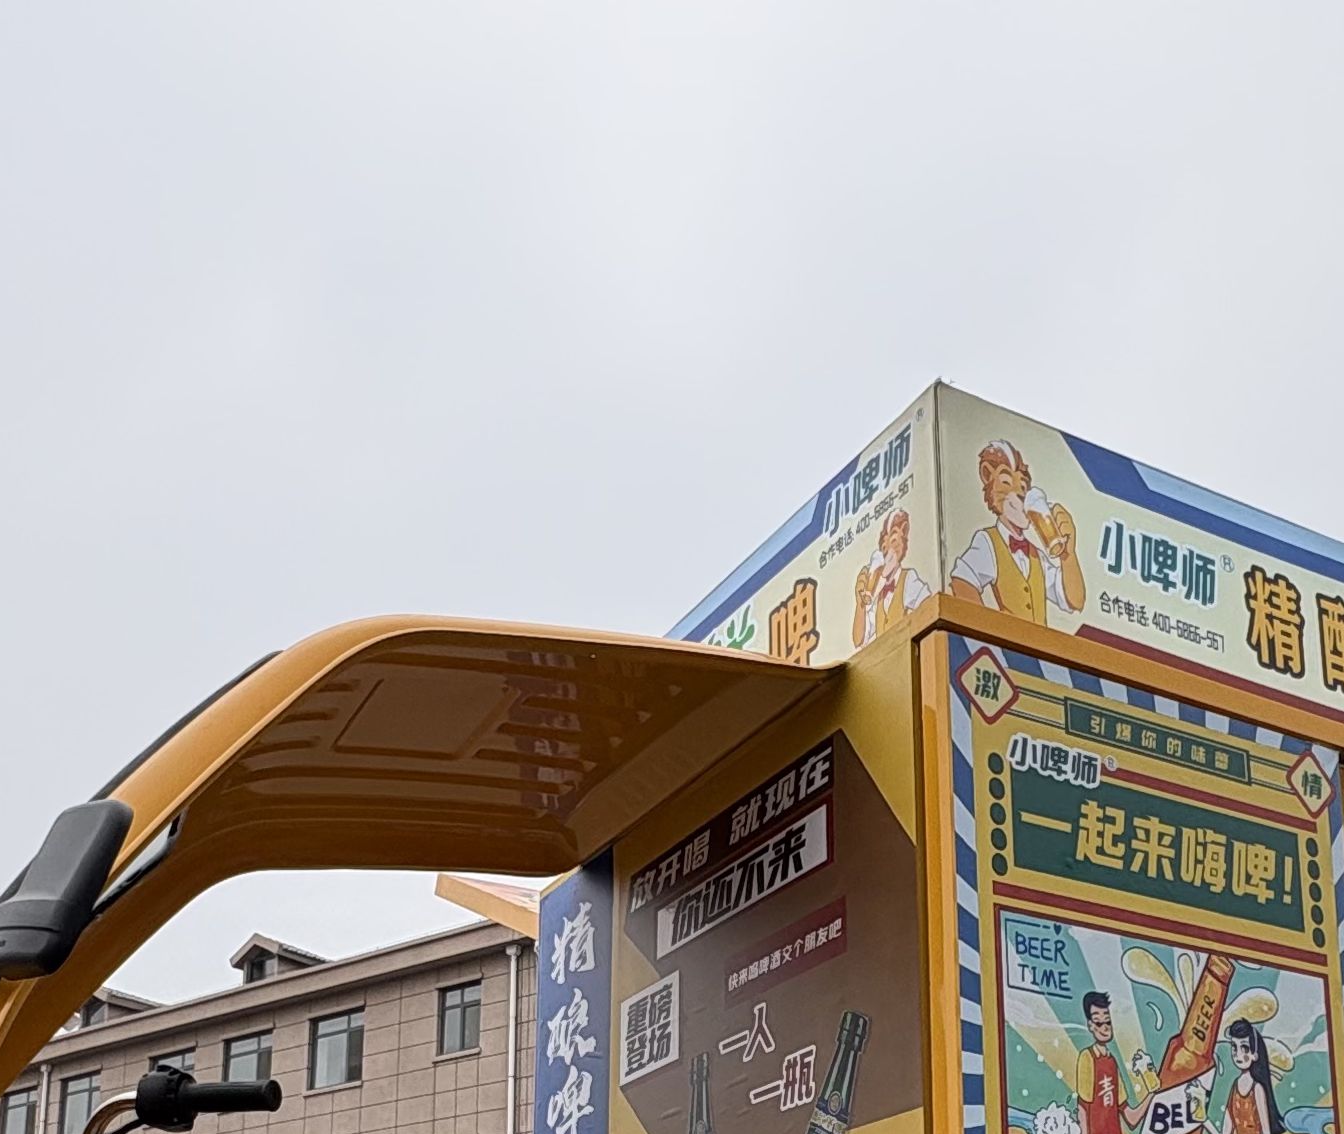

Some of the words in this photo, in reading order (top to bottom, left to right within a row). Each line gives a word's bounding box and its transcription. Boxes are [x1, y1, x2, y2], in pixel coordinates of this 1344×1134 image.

[974, 666, 1001, 702] 激
[1009, 737, 1100, 785] 小啤师
[1301, 769, 1322, 801] 情
[630, 828, 711, 913] 放开喝
[728, 746, 833, 846] 就现在
[670, 820, 808, 948] 你还不来
[1014, 931, 1070, 966] BEER
[1017, 963, 1072, 992] TIME
[625, 982, 673, 1042] 重磅
[718, 1001, 777, 1063] 一人
[1192, 995, 1217, 1043] BEER
[624, 1019, 672, 1078] 登场
[749, 1044, 817, 1112] 一瓶
[1097, 1074, 1116, 1107] 青
